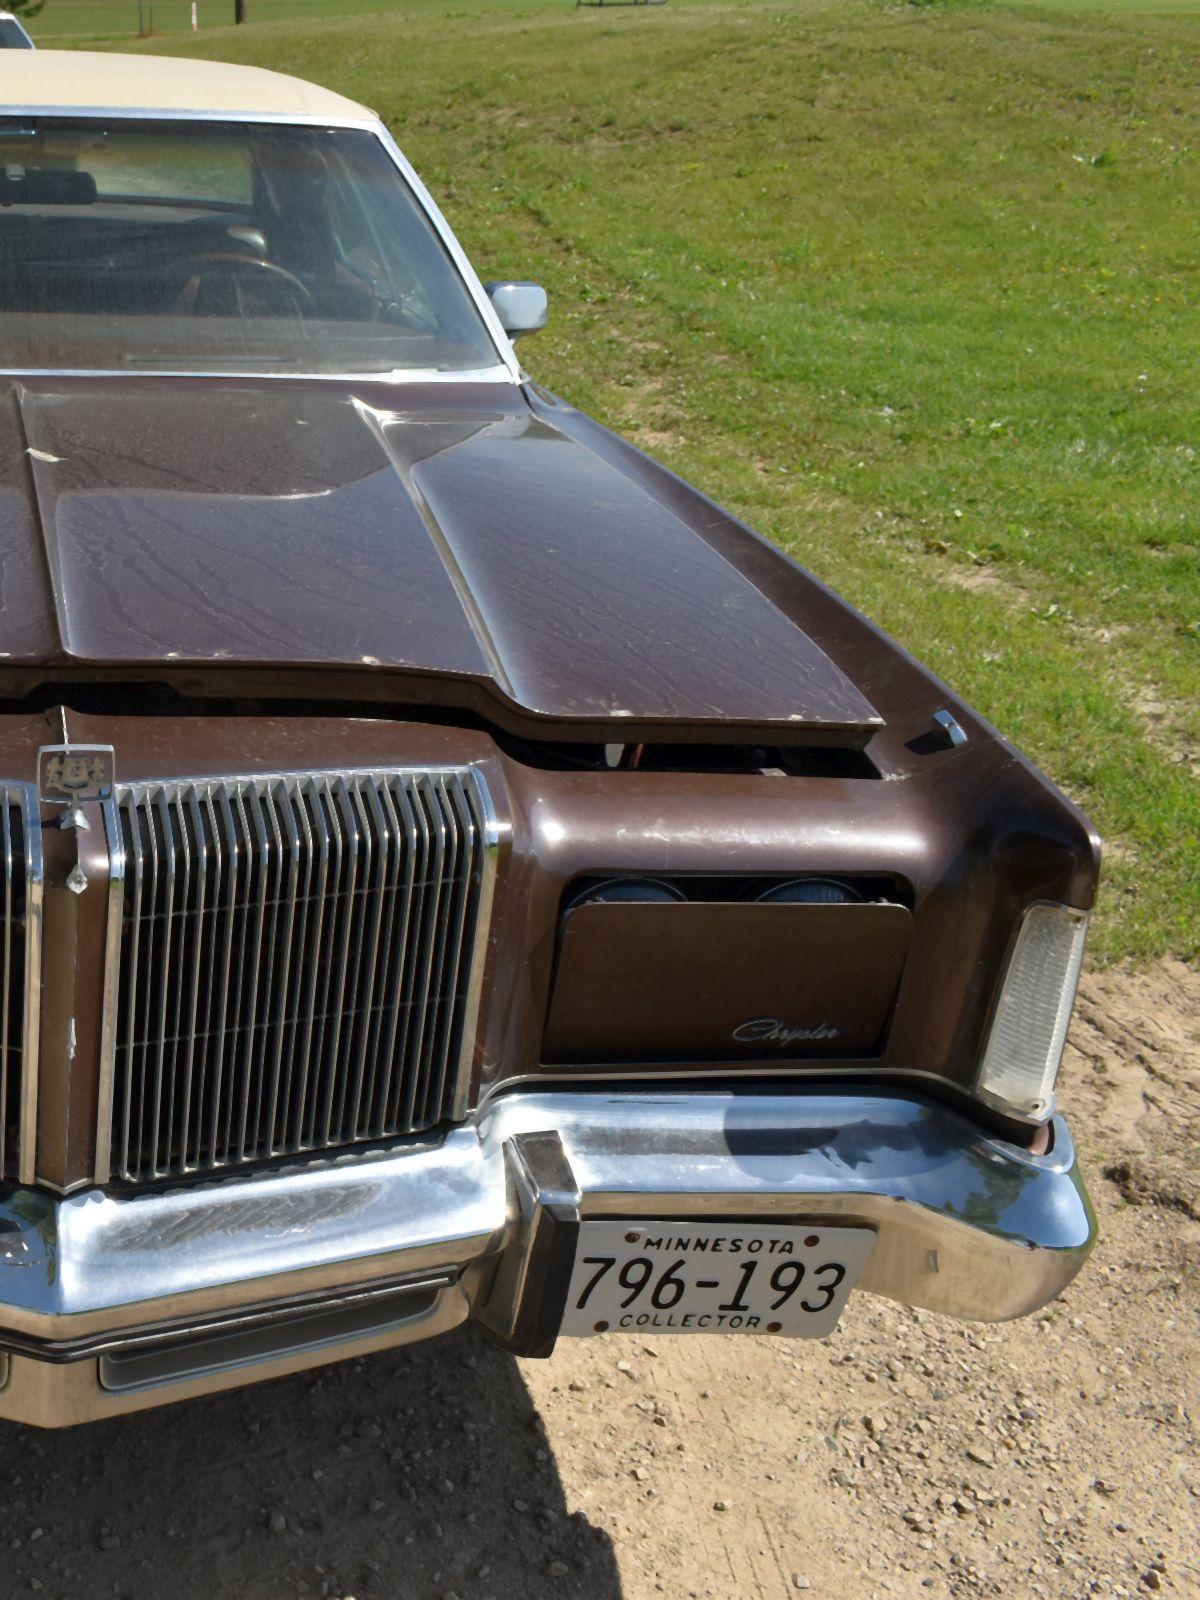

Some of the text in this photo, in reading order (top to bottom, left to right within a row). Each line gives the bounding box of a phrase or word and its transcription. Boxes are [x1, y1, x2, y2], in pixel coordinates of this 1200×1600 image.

[732, 1018, 840, 1046] Chrysler
[643, 1237, 794, 1254] MINNESOTA
[576, 1257, 846, 1313] 796-193
[619, 1314, 761, 1329] COLLECTOR
